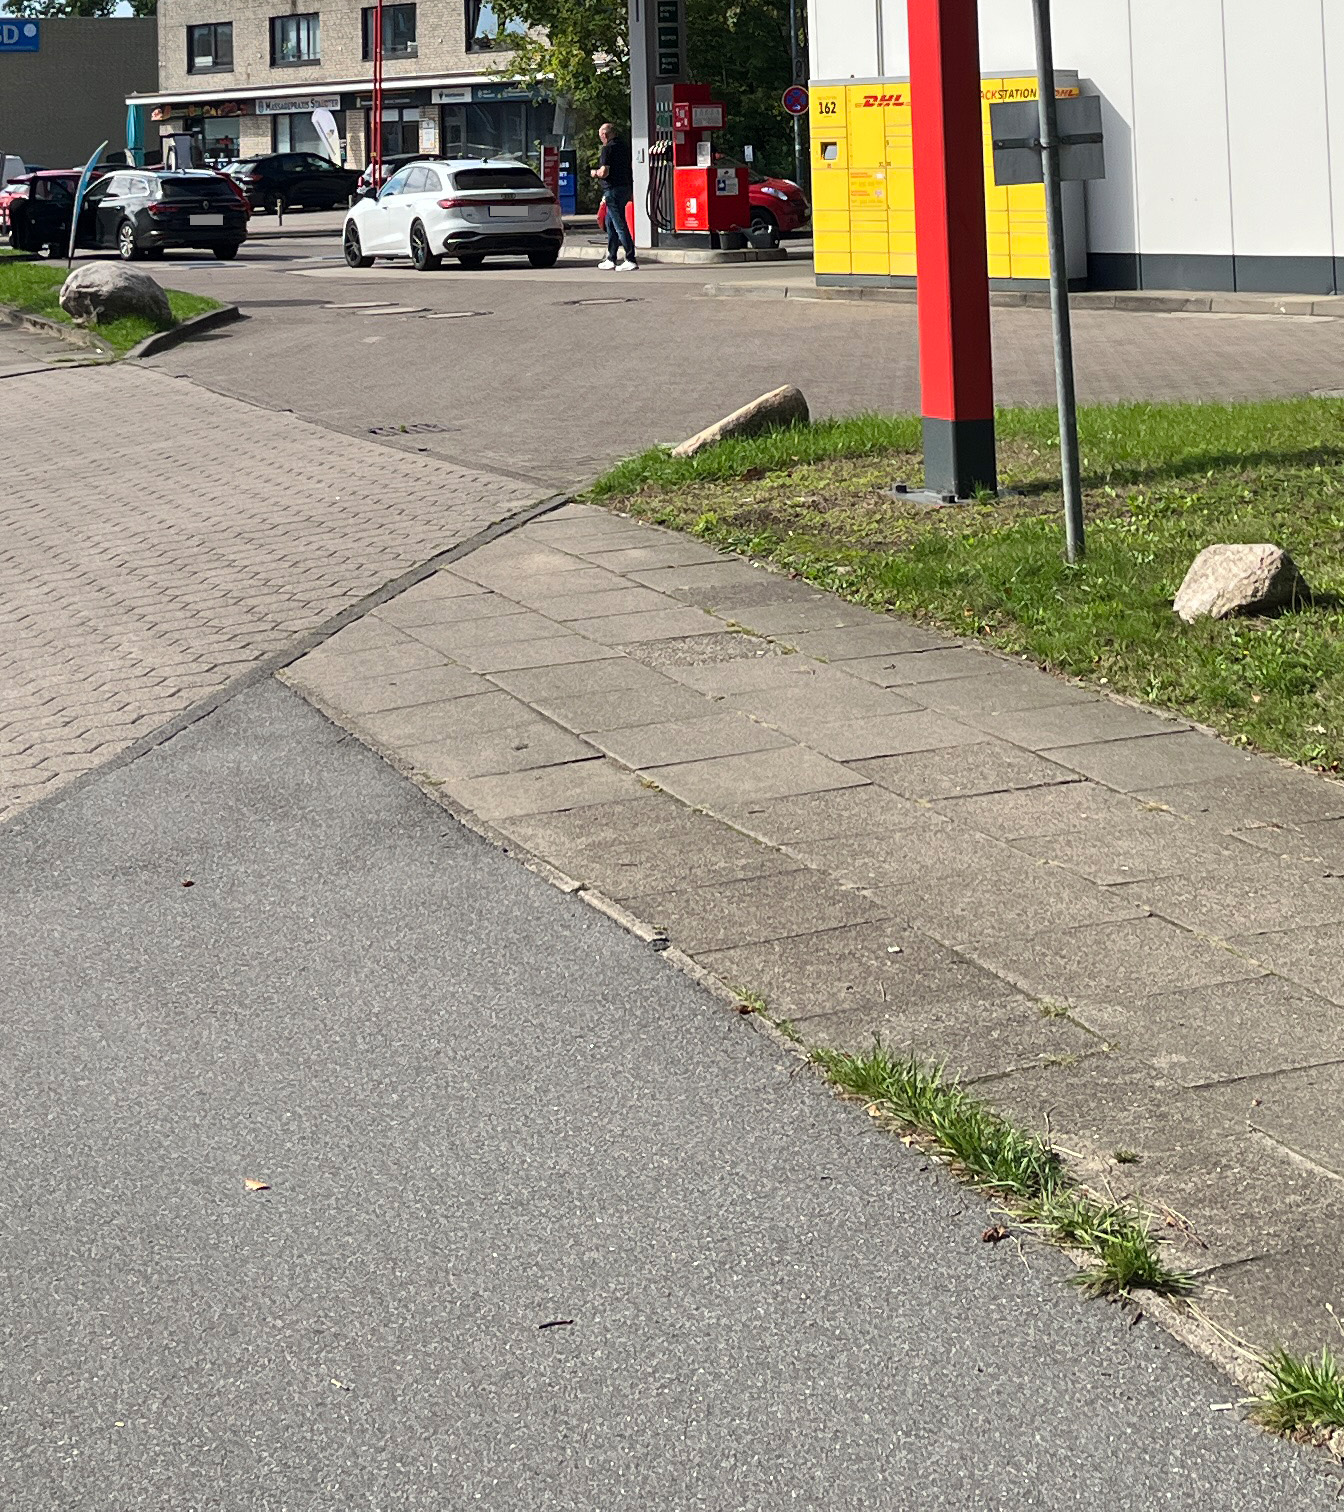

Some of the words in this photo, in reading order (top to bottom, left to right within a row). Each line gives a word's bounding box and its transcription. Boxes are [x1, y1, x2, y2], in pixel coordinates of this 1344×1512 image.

[862, 94, 904, 108] DHL
[981, 88, 1037, 101] ACKSTATION
[818, 101, 837, 115] 162
